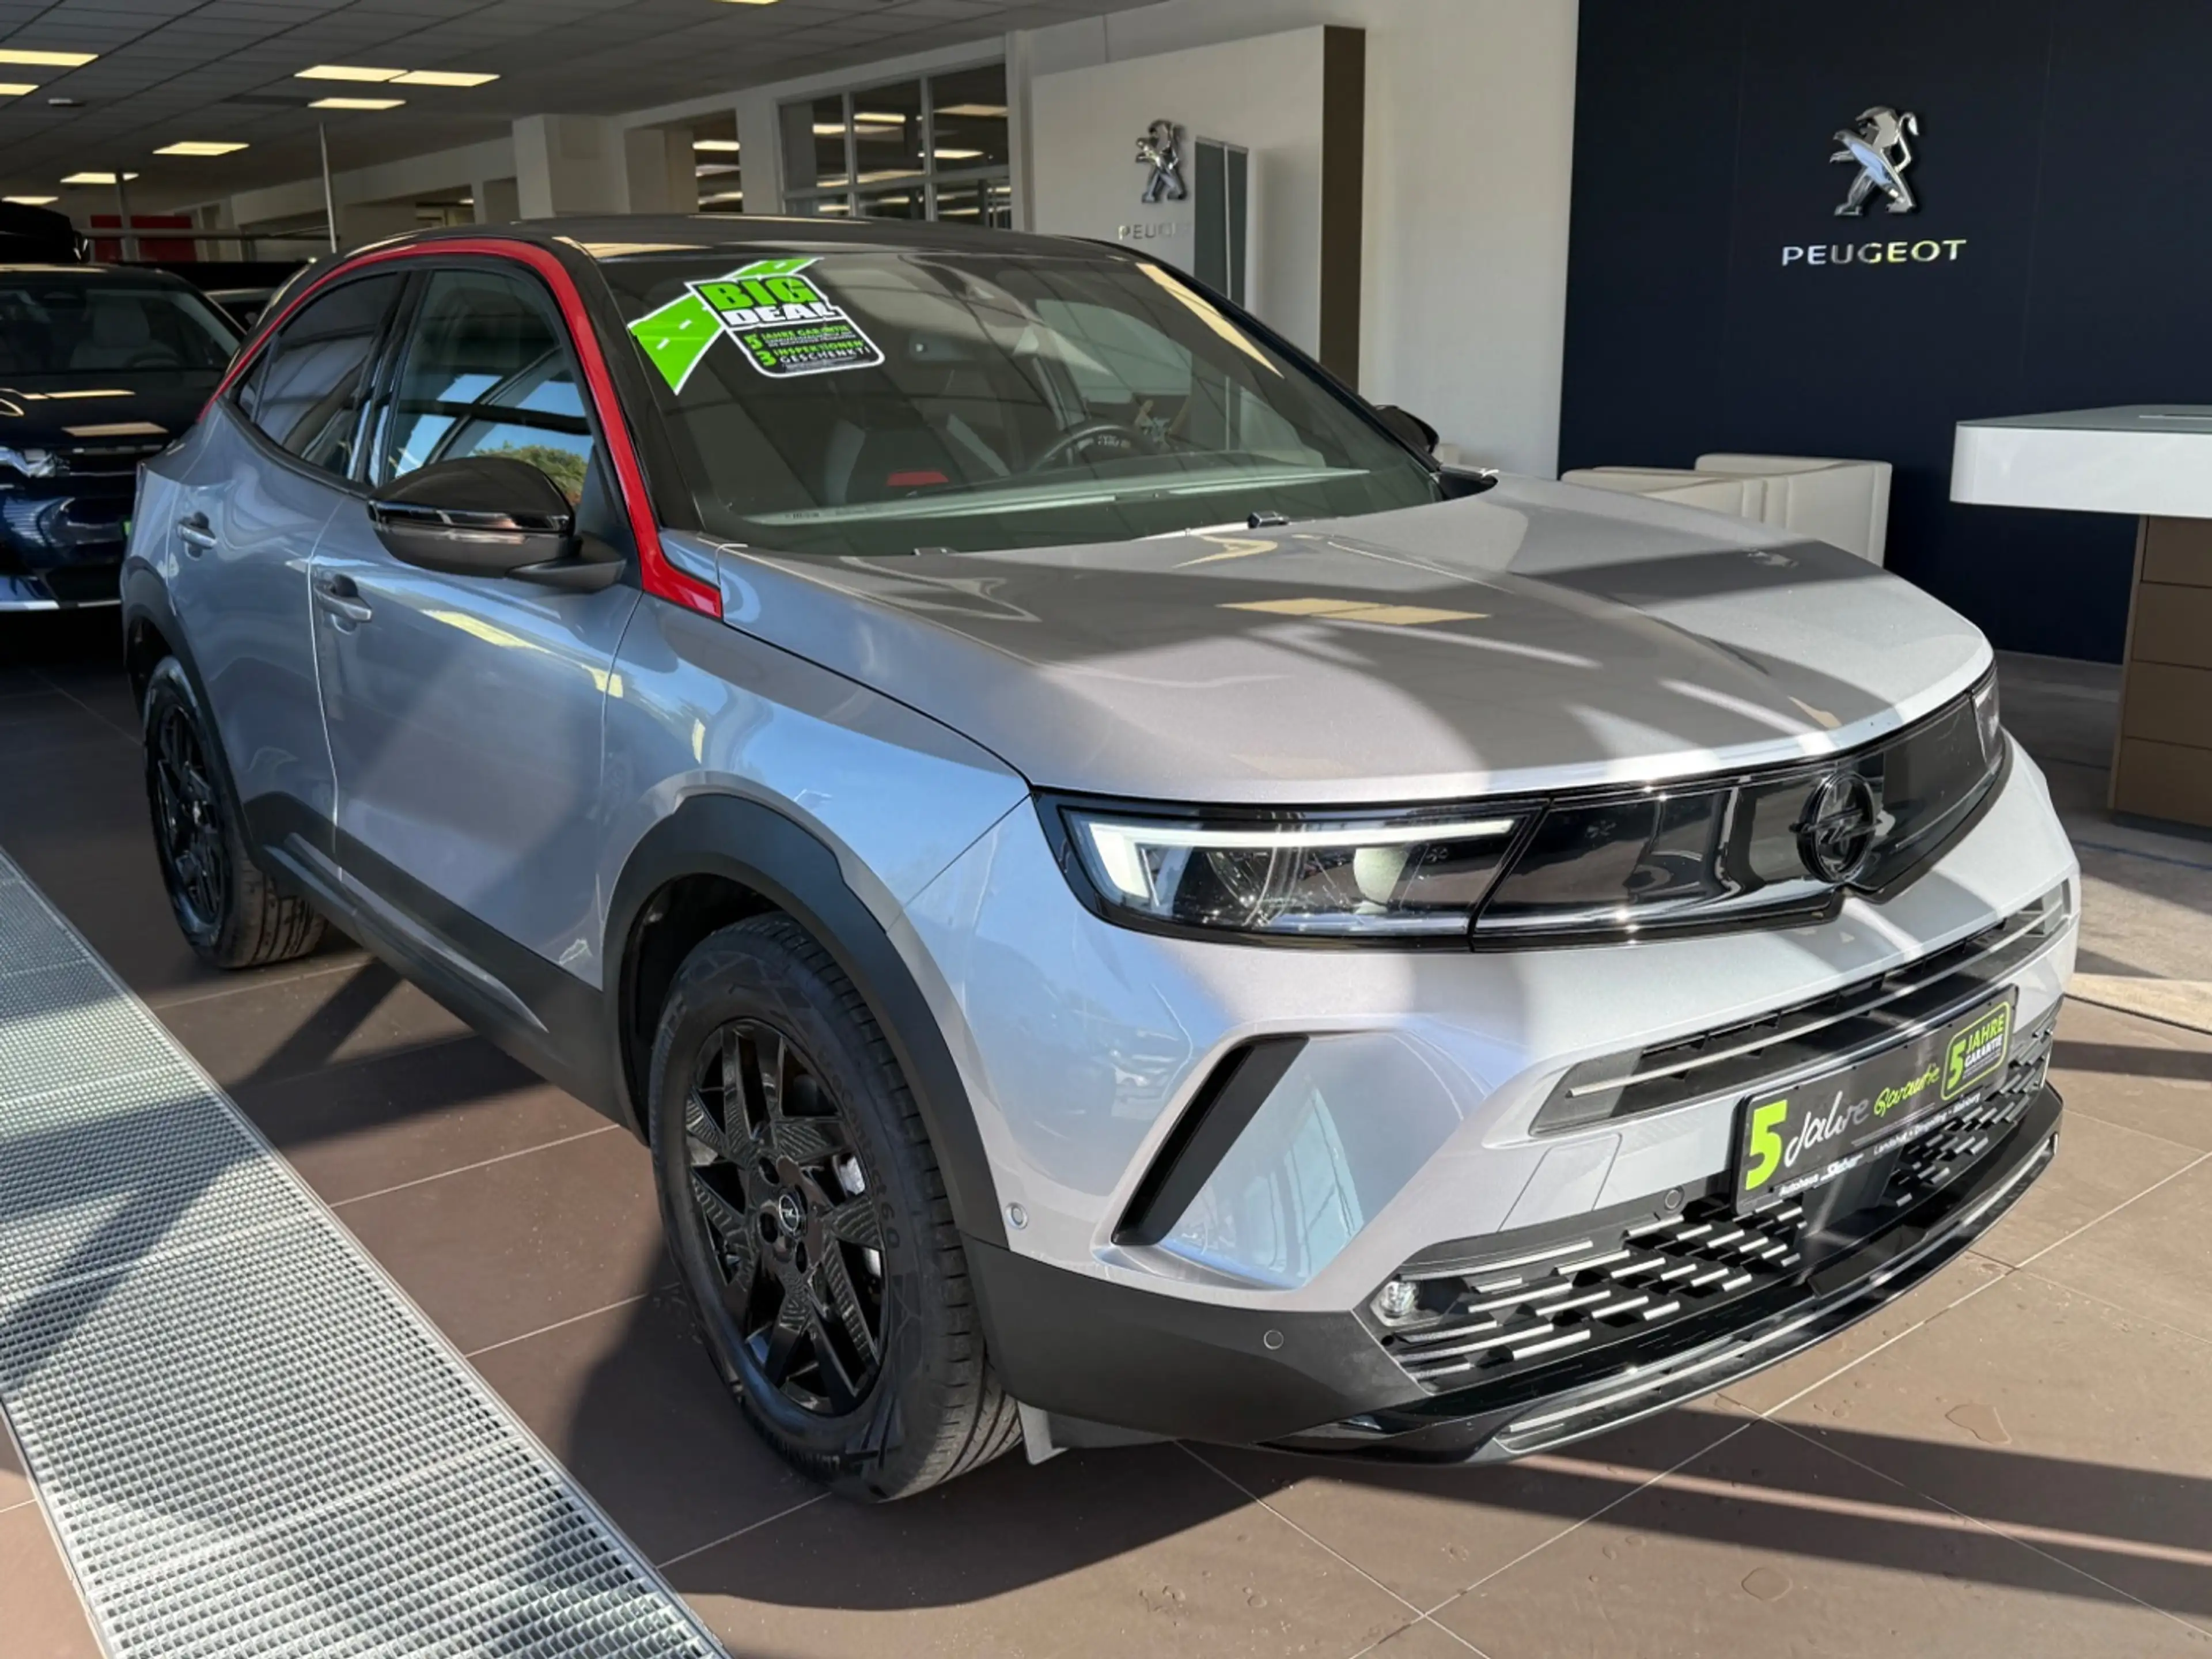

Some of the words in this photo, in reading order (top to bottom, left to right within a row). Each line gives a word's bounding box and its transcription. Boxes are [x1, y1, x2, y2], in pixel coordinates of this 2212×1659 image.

[1782, 239, 1967, 266] PEUGEOT
[697, 276, 819, 311] BIG
[721, 302, 837, 326] DEAL
[744, 334, 763, 350] 5
[755, 350, 777, 366] 3
[1947, 1039, 1967, 1090] 5
[1966, 1014, 2005, 1054] JAHRE
[1745, 1099, 1787, 1191] 5
[1784, 1091, 1870, 1168] Jahre
[1873, 1062, 1940, 1118] Garantie
